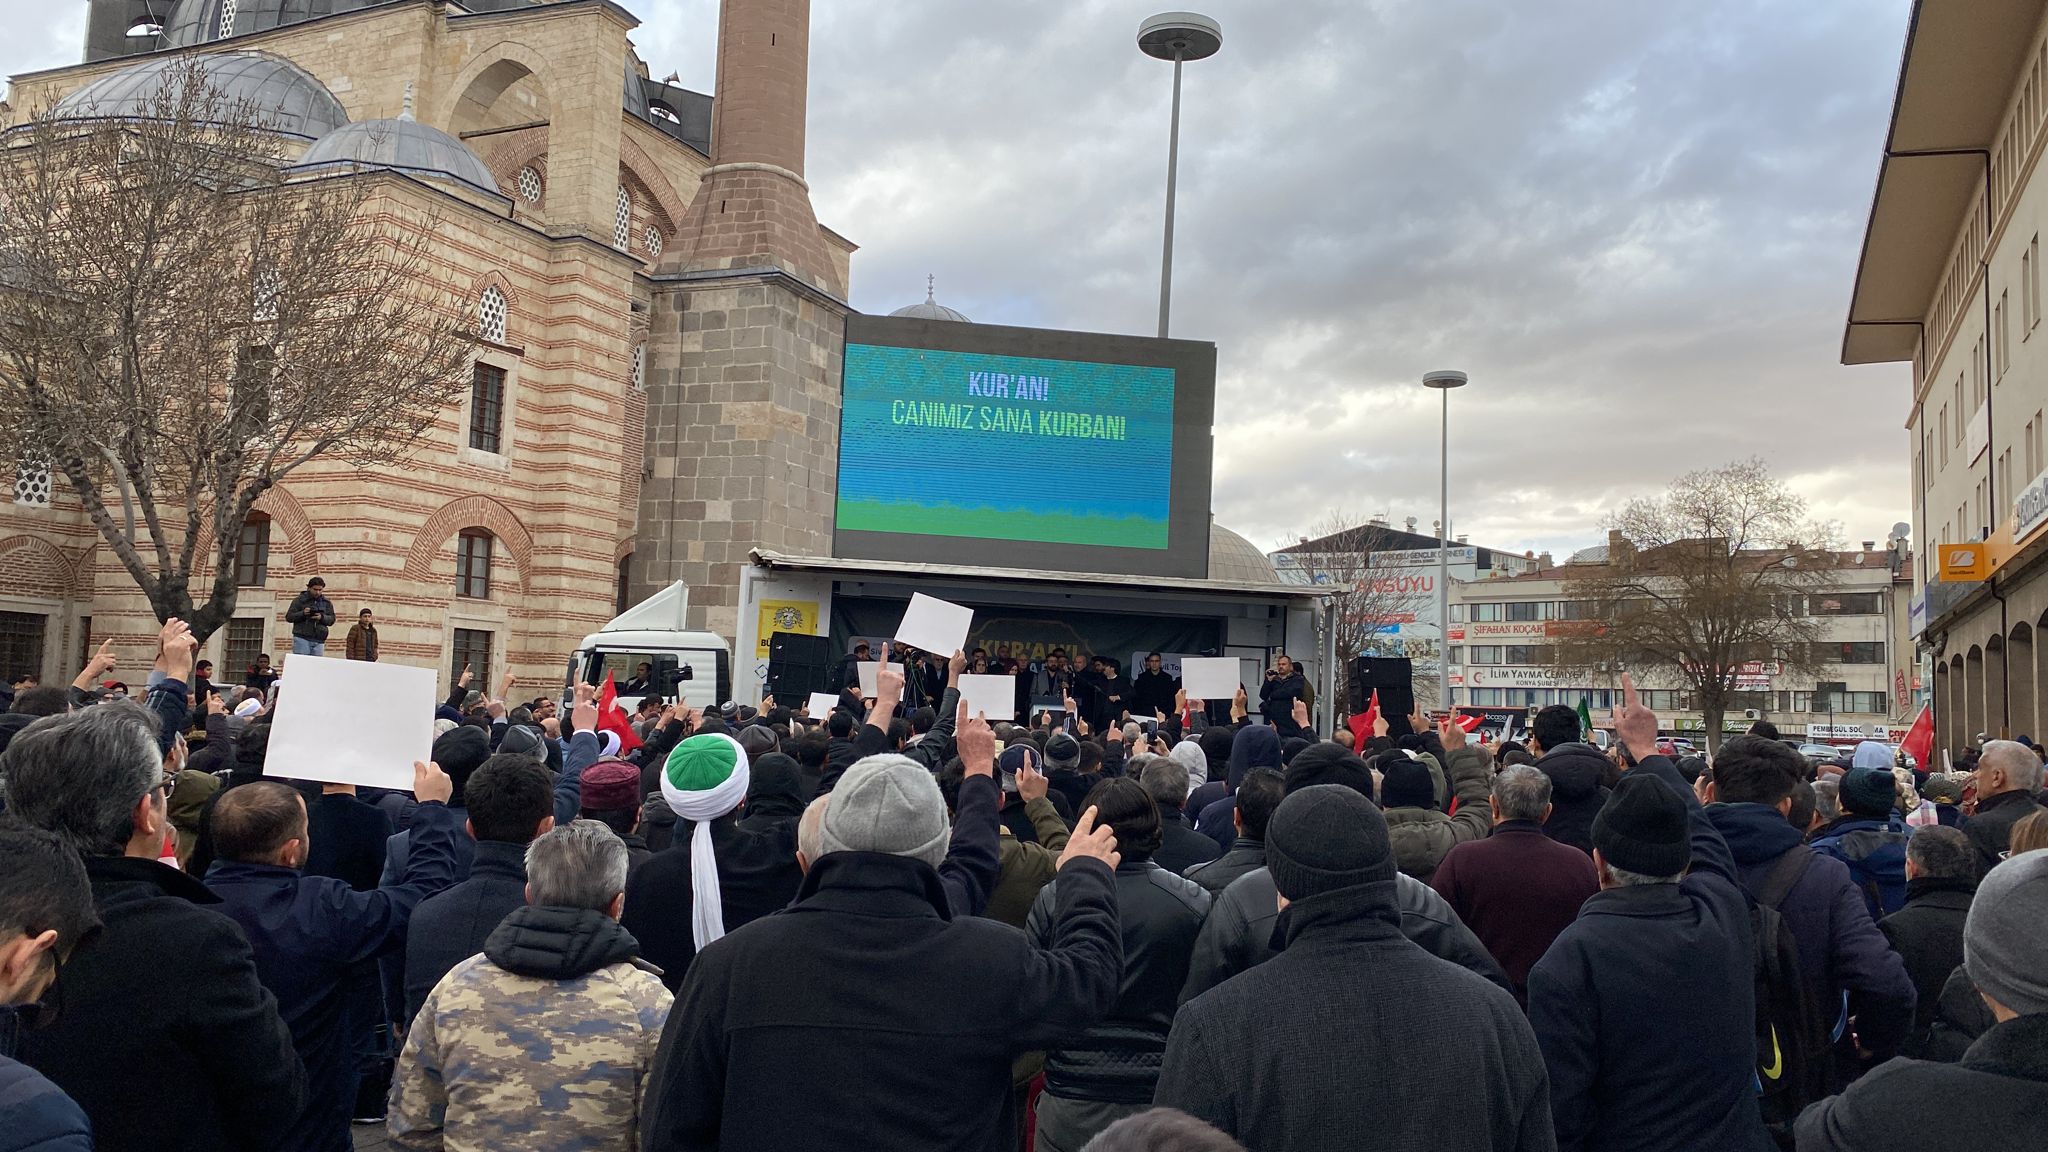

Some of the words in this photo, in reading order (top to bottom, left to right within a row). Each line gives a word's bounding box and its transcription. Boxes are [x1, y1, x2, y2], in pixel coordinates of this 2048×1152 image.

[968, 371, 1049, 401] KUR'AN!
[892, 399, 974, 431] CANIMIZ
[980, 406, 1033, 435] SANA
[1038, 410, 1127, 441] KURBAN!
[1511, 668, 1542, 678] YAYMA
